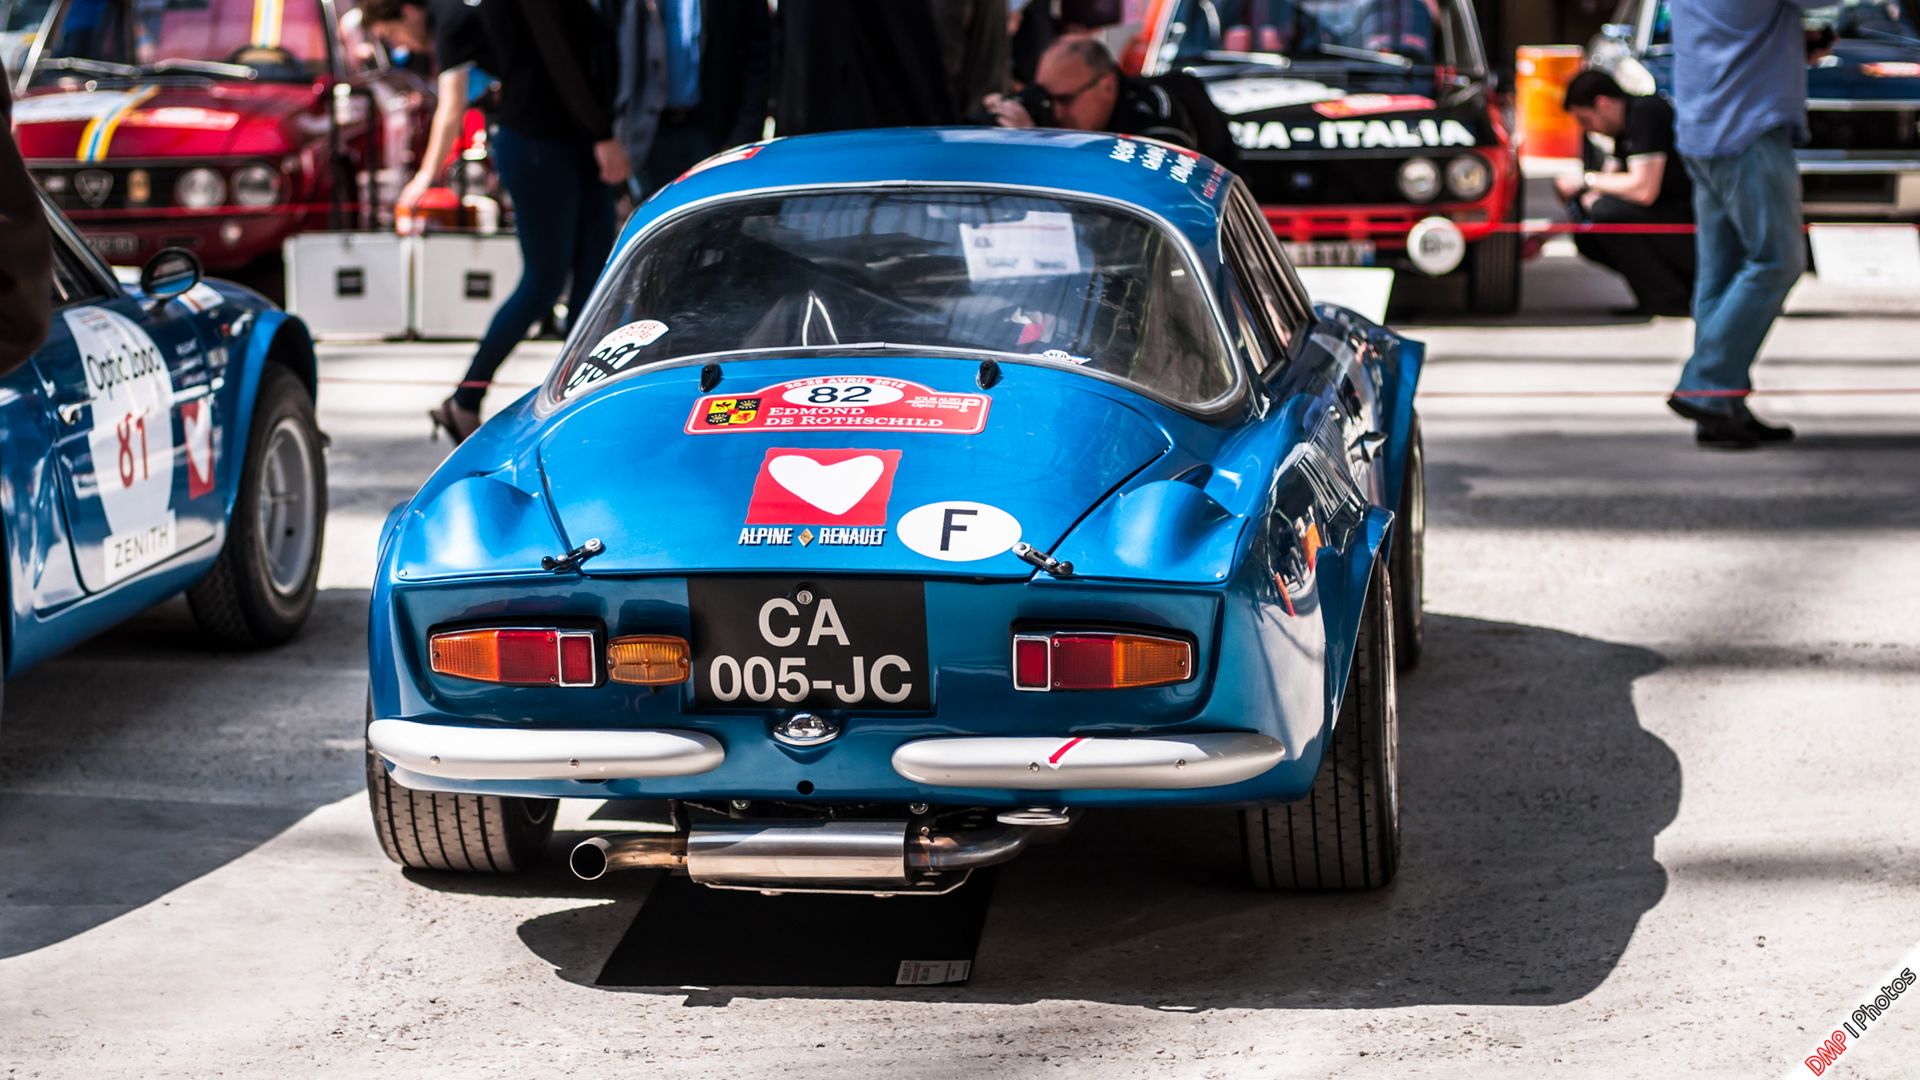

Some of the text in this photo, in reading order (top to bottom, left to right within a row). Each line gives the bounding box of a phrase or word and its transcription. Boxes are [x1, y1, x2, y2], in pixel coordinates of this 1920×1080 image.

[807, 385, 872, 404] 82
[827, 376, 871, 384] AVRIL
[764, 416, 944, 427] DE ROTHSCHILD
[767, 407, 866, 416] EDMOND
[117, 412, 149, 489] 81
[114, 523, 169, 569] ZENITH
[738, 527, 887, 547] ALPINE RENAULT
[939, 508, 978, 552] F
[758, 597, 851, 648] CA
[709, 654, 913, 703] 005-JC
